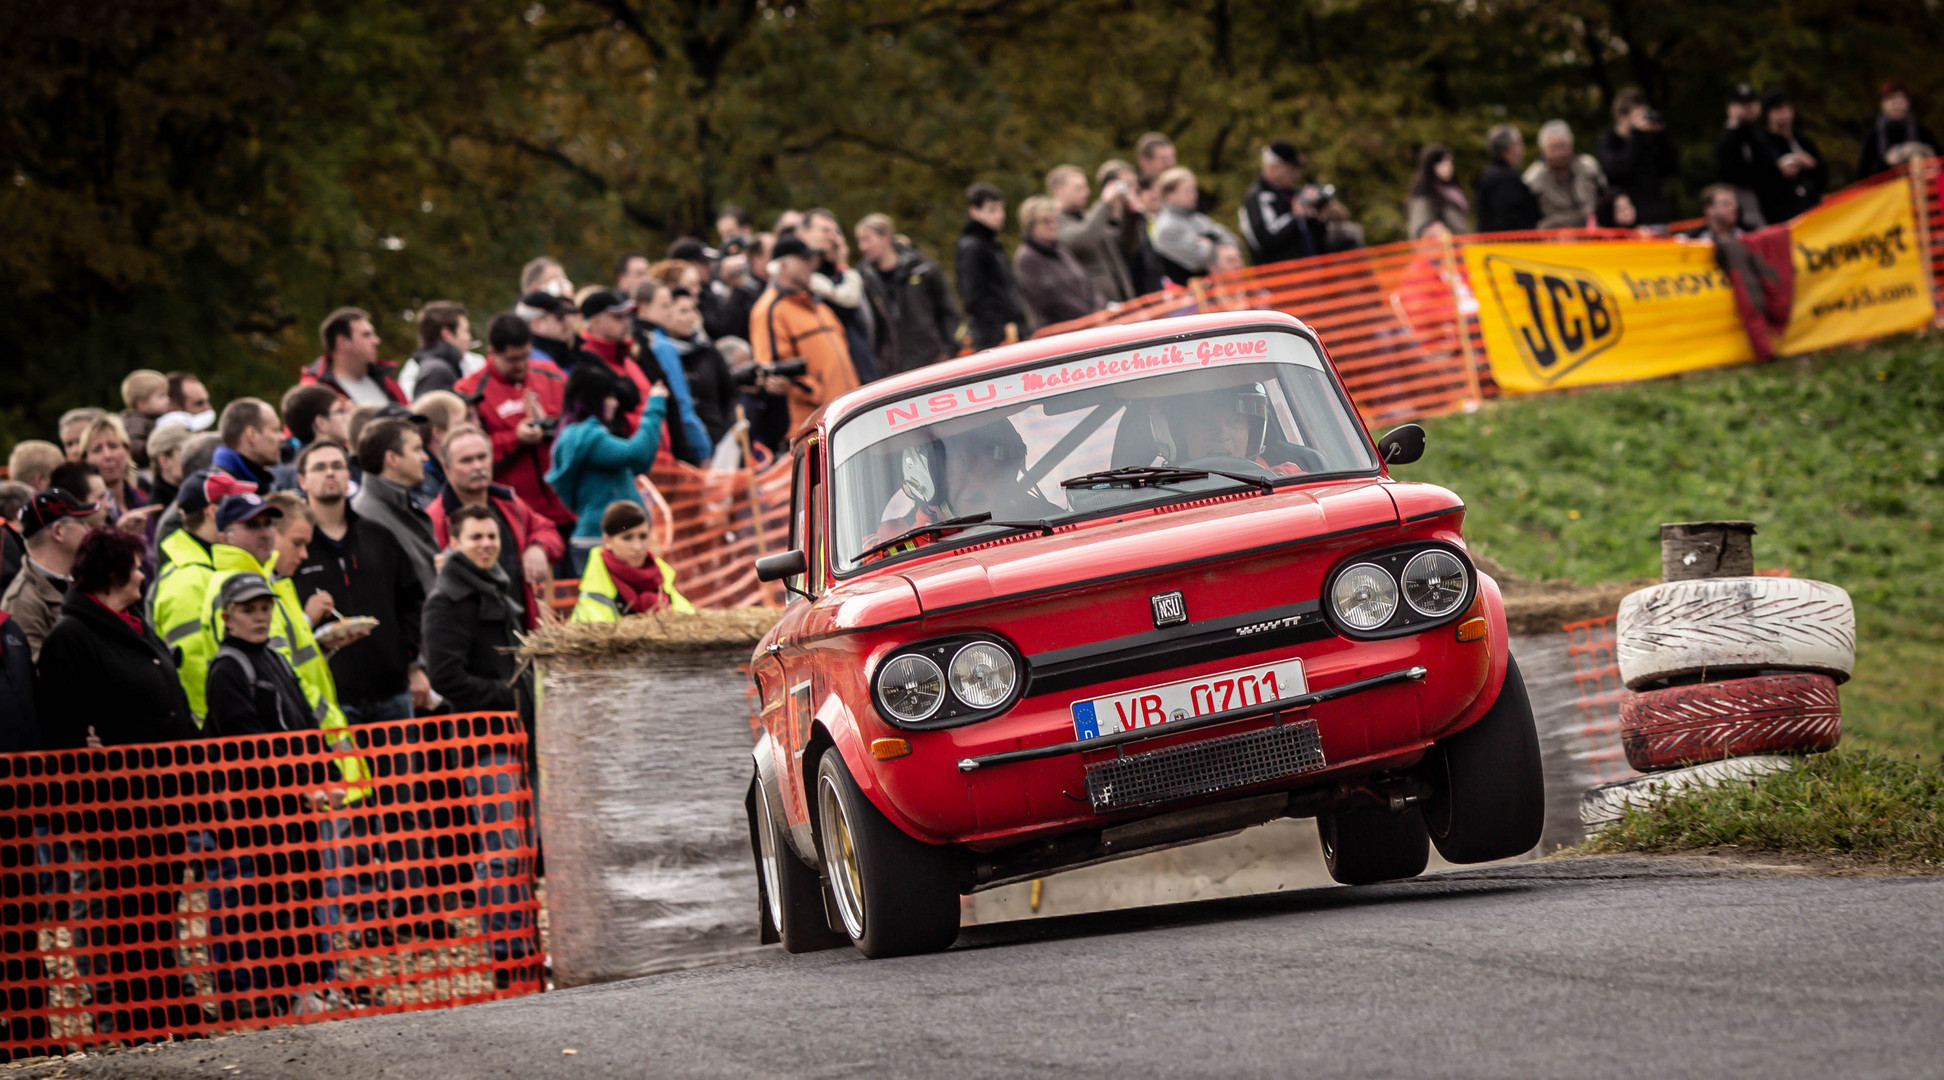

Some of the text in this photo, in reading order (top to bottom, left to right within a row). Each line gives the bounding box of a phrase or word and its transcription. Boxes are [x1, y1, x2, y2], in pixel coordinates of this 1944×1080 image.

[1797, 225, 1907, 272] bewegt
[1513, 268, 1611, 368] JCB
[1158, 597, 1181, 619] NSU
[1282, 615, 1302, 628] TT
[1115, 694, 1168, 732] VB
[1190, 670, 1280, 718] 0701
